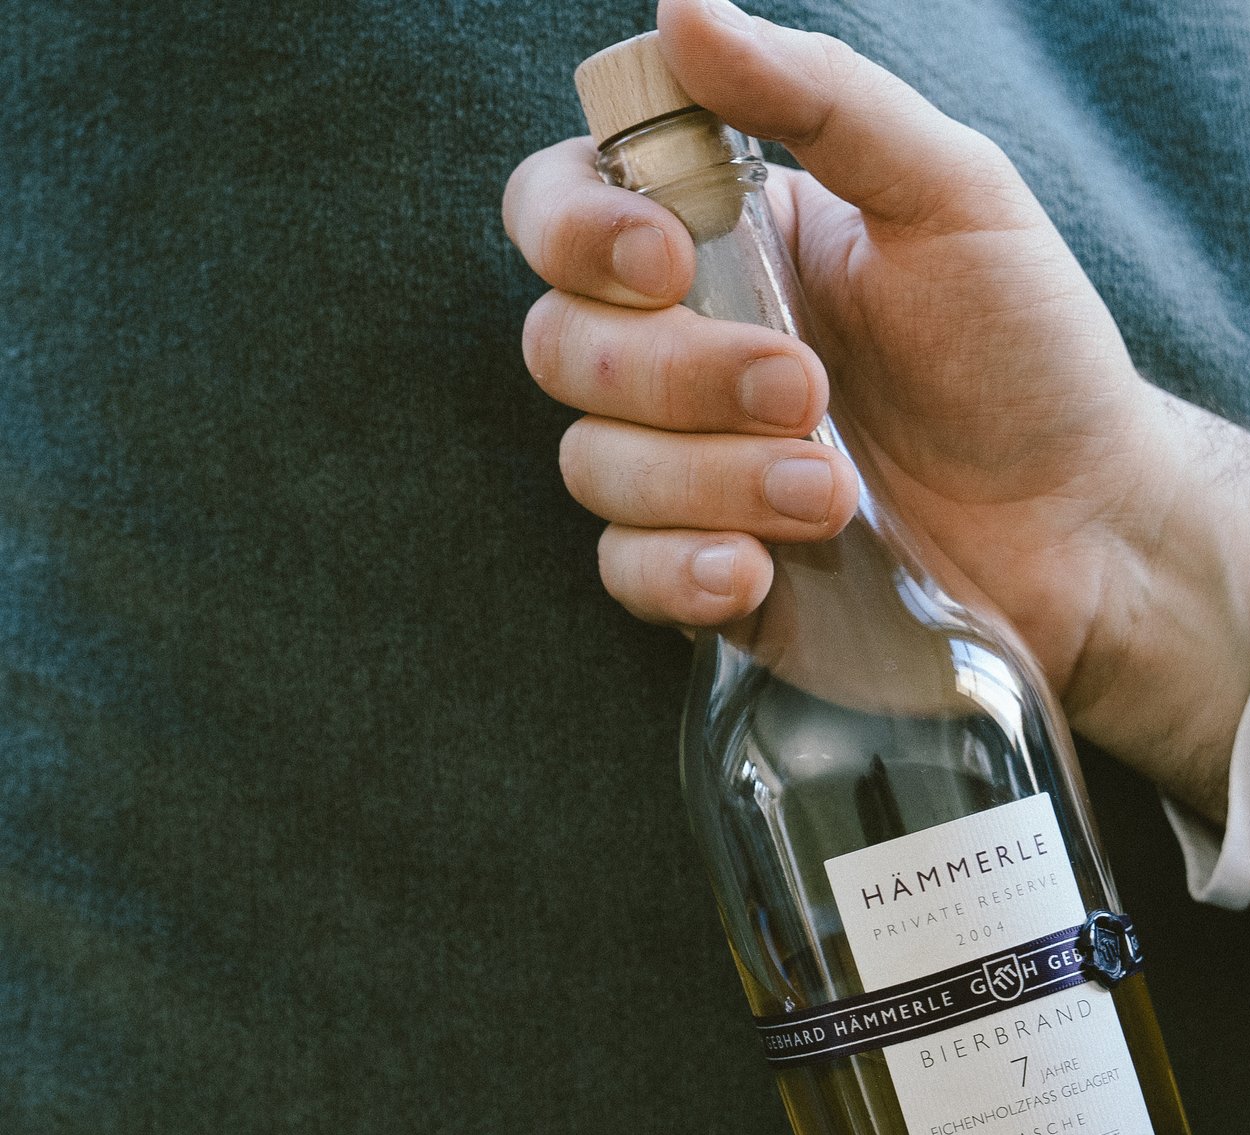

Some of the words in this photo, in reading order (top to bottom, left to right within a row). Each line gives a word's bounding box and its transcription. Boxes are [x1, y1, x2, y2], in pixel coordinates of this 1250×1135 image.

[861, 832, 1049, 909] HÄMMERLE
[873, 903, 965, 940] PRIVATE
[978, 873, 1059, 906] RESERVE
[957, 921, 1005, 946] 2004
[765, 1027, 826, 1050] GEBHARD
[833, 990, 954, 1037] HÄMMERLE
[1047, 948, 1084, 970] GEB
[920, 999, 1092, 1069] BIERBRAND
[1010, 1056, 1029, 1087] 7
[1039, 1057, 1081, 1083] JAHRE
[1061, 1067, 1121, 1099] GELAGERT
